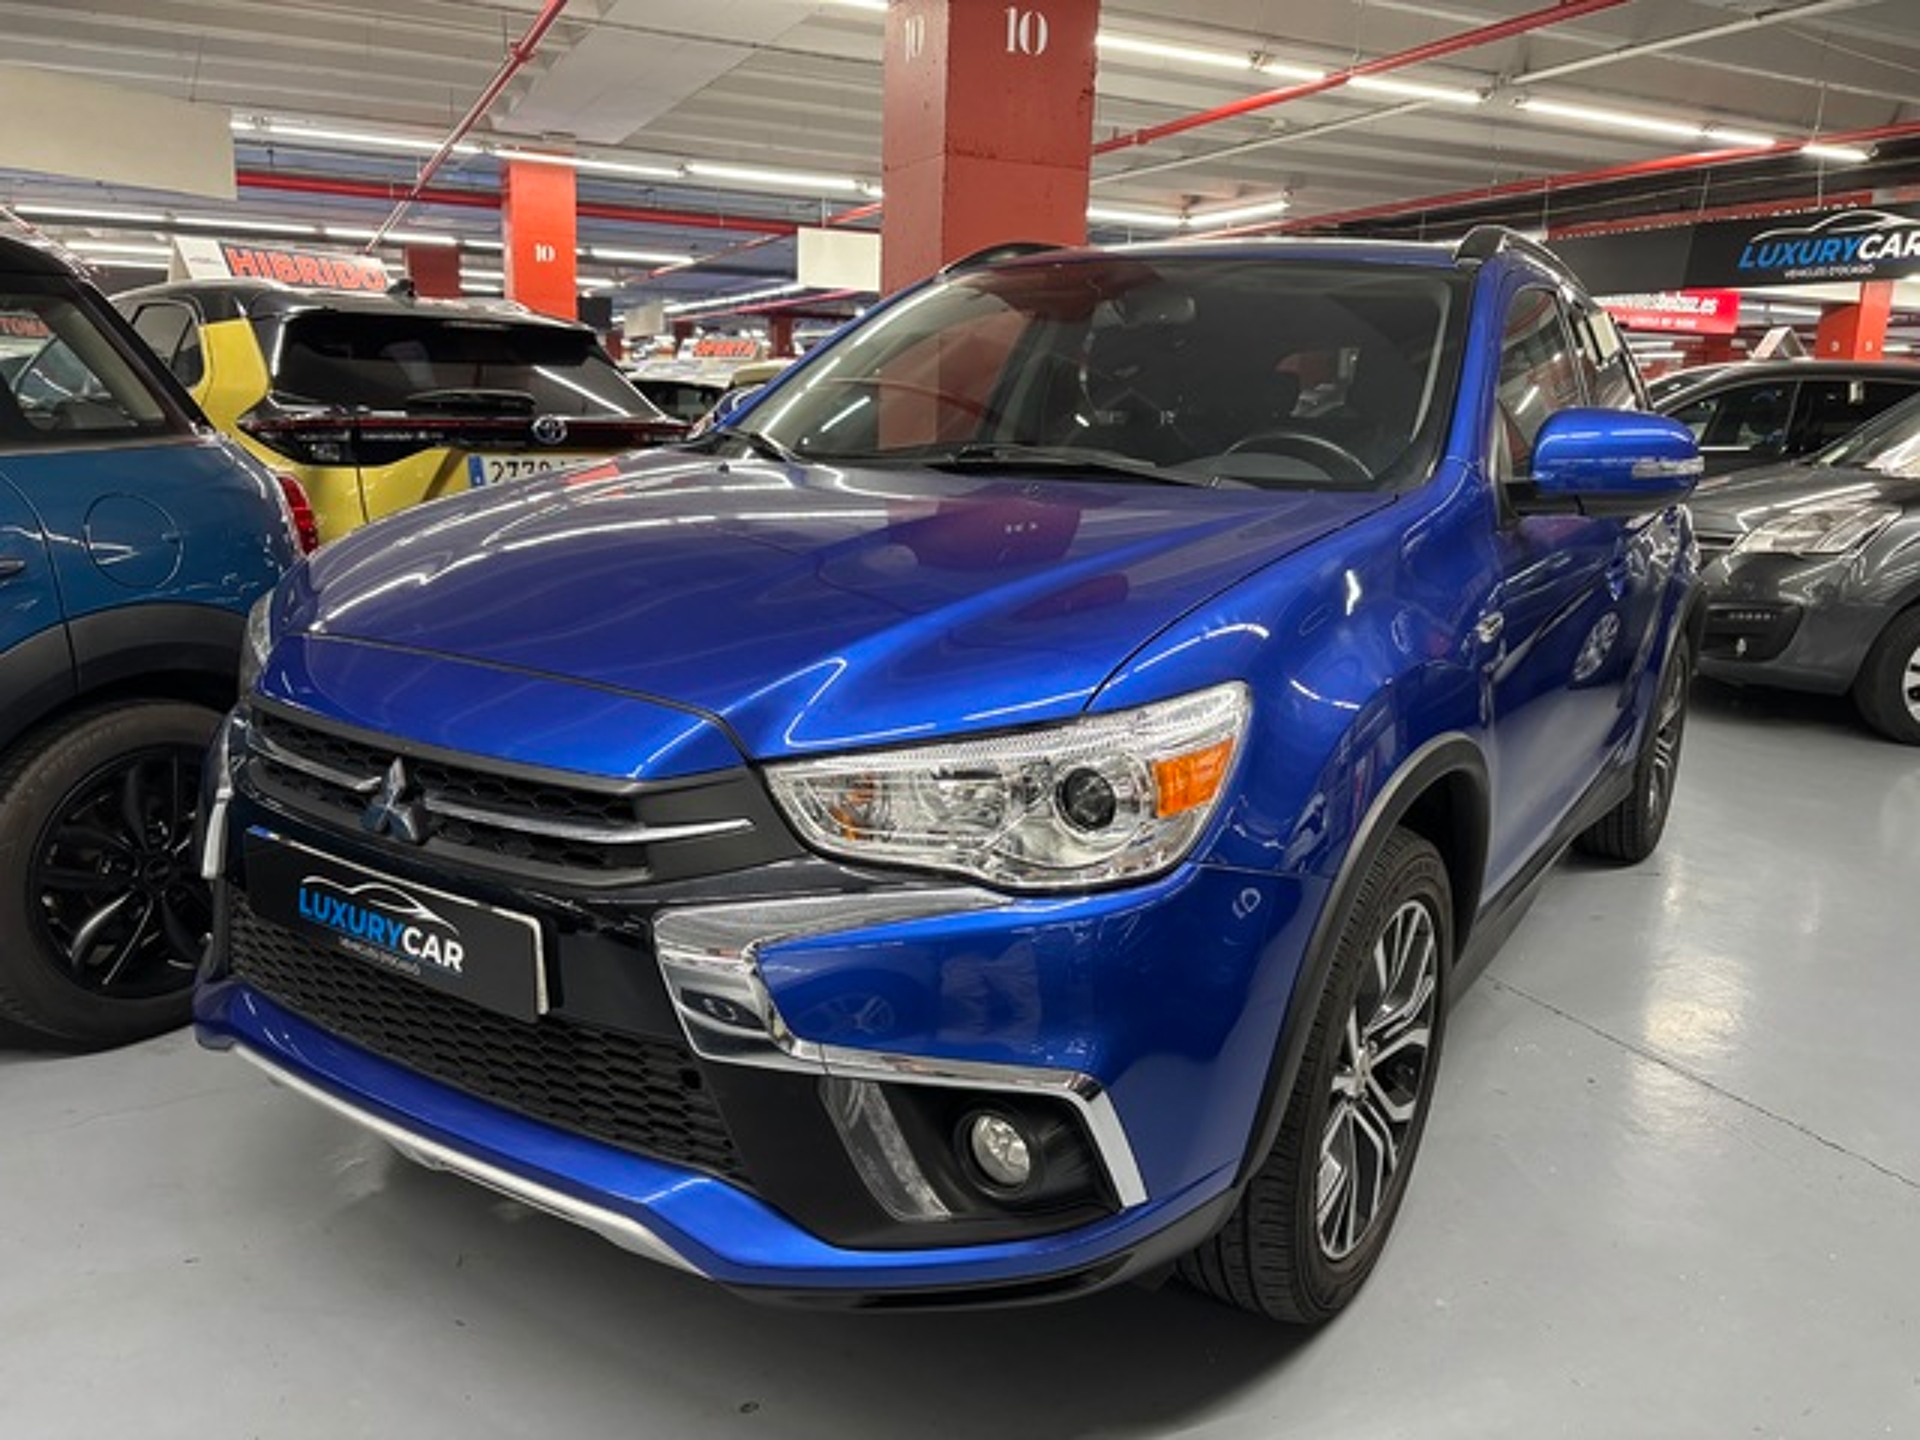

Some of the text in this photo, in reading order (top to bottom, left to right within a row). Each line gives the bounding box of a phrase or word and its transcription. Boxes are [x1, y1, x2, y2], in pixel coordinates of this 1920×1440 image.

[1004, 7, 1048, 55] 10
[225, 246, 387, 291] HIBRIDO
[535, 242, 556, 263] 10
[1738, 231, 1920, 271] LUXURYCAR
[299, 886, 465, 974] LUXURYCAR
